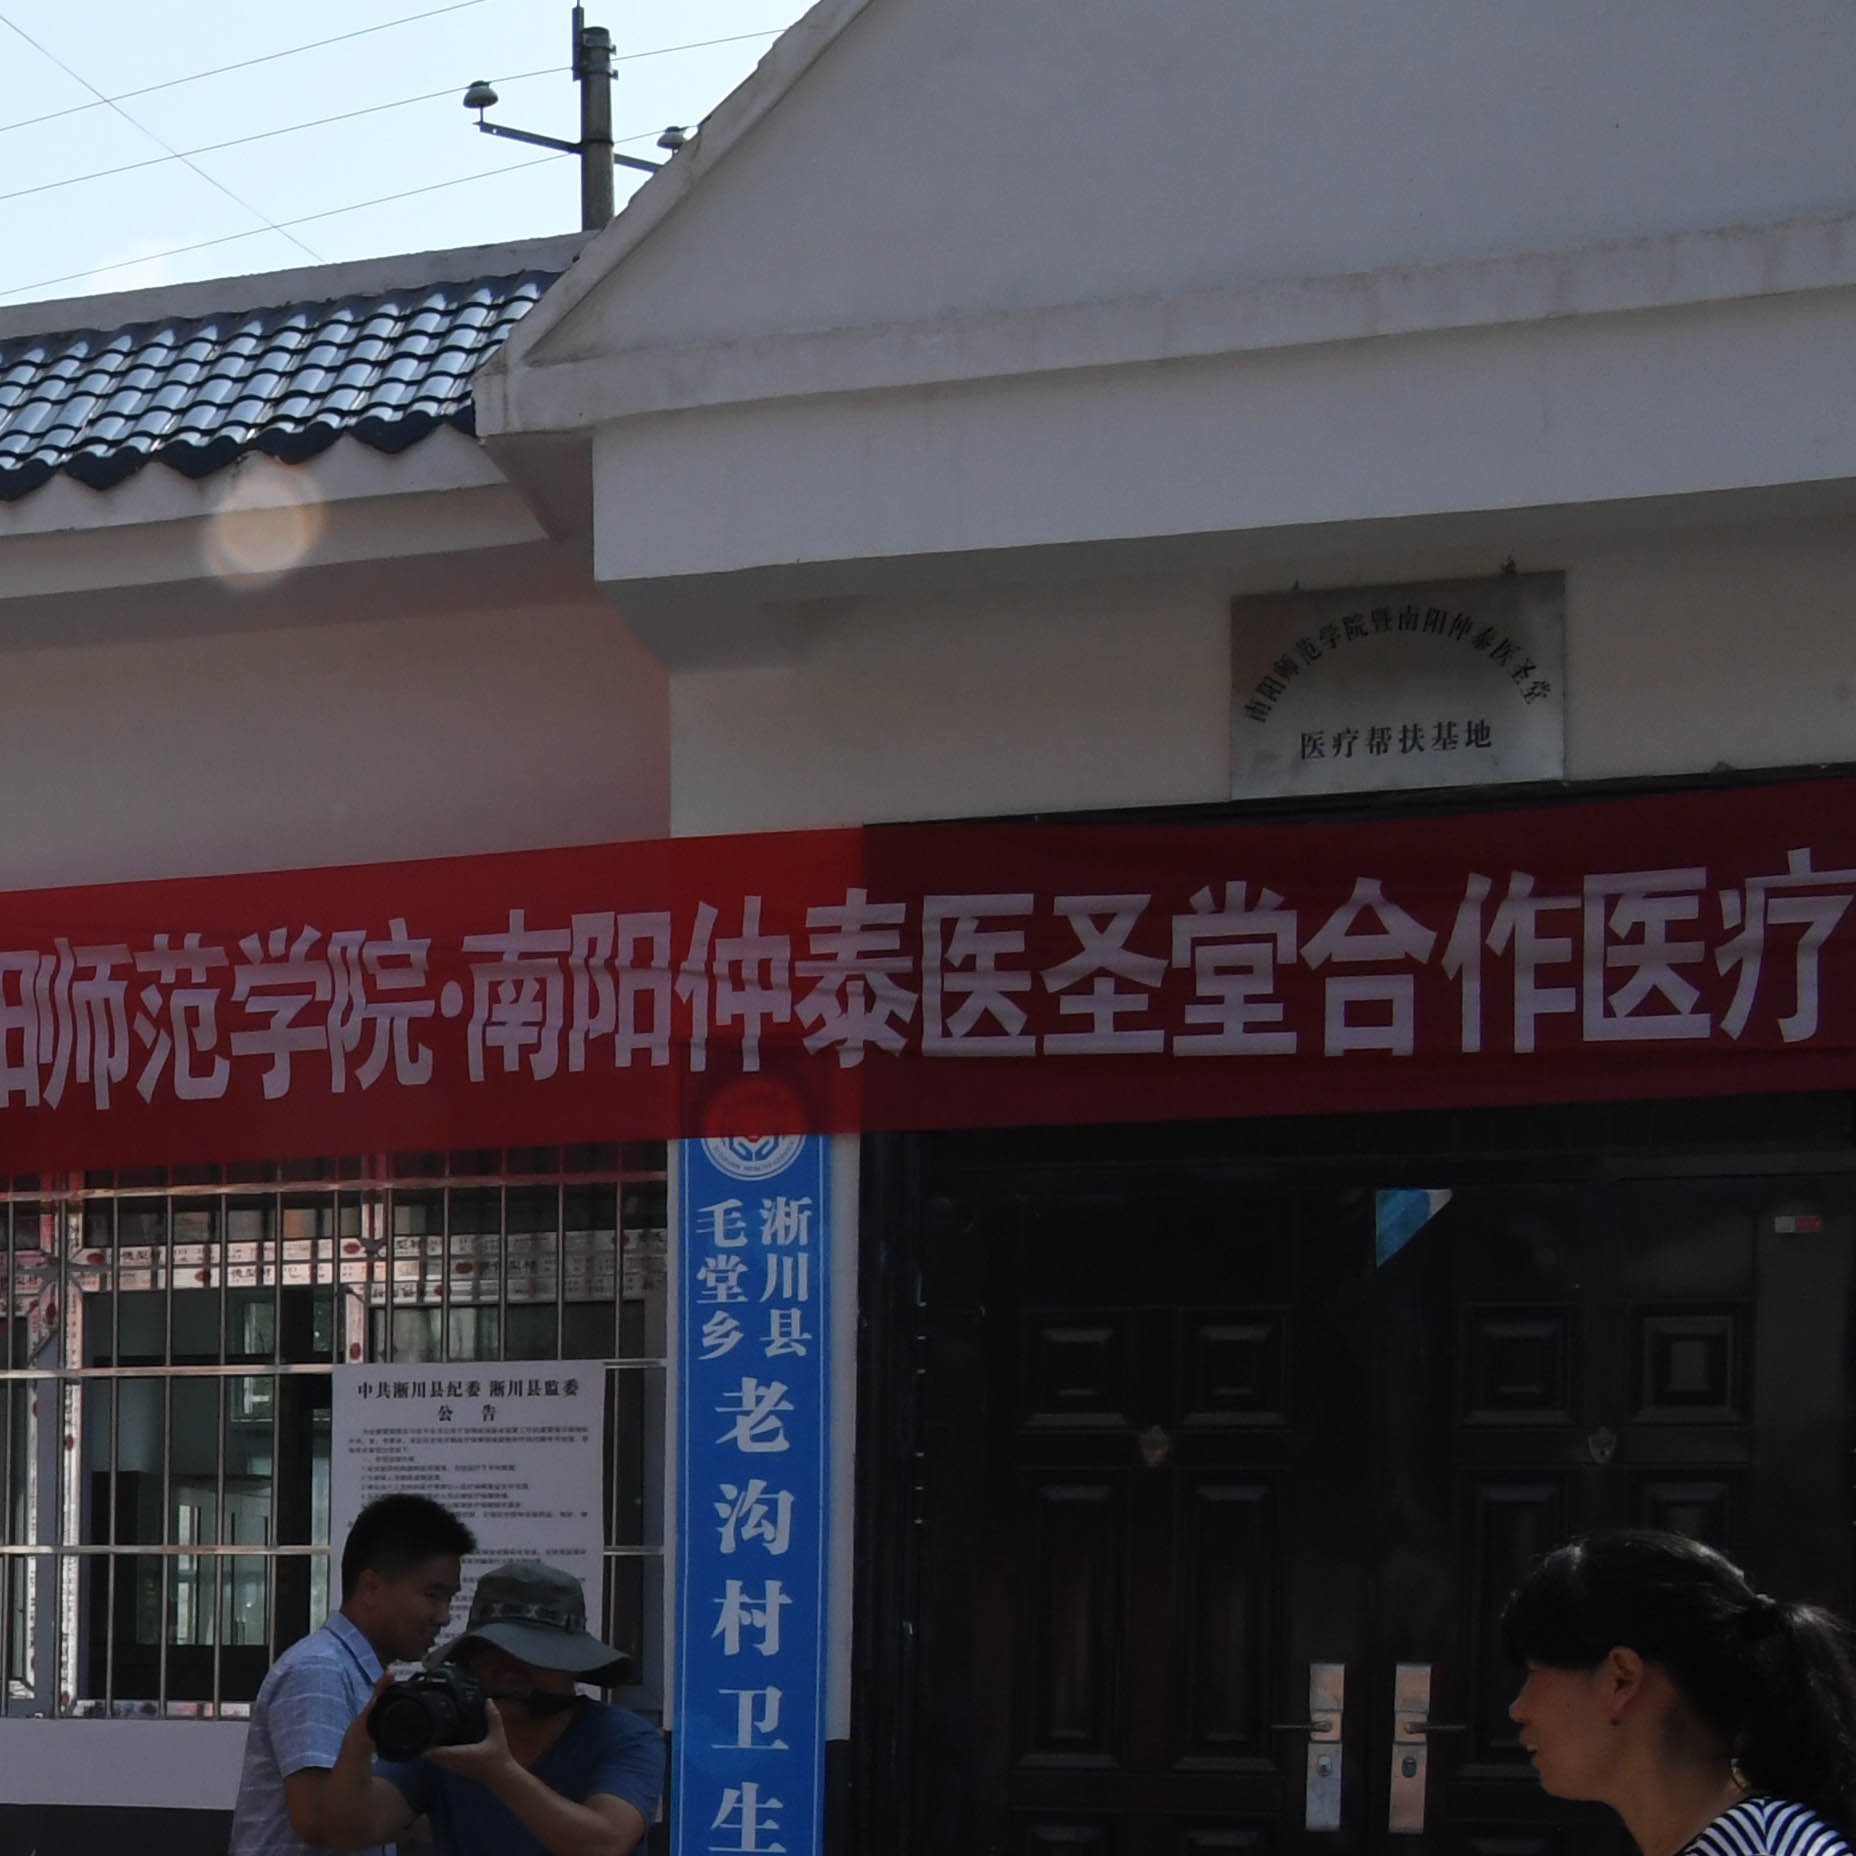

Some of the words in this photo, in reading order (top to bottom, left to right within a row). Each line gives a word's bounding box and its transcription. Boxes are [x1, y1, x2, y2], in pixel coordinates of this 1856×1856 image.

[1301, 719, 1492, 760] 医疗帮扶基地
[695, 1200, 749, 1361] 毛堂乡
[759, 1197, 812, 1359] 淅川县
